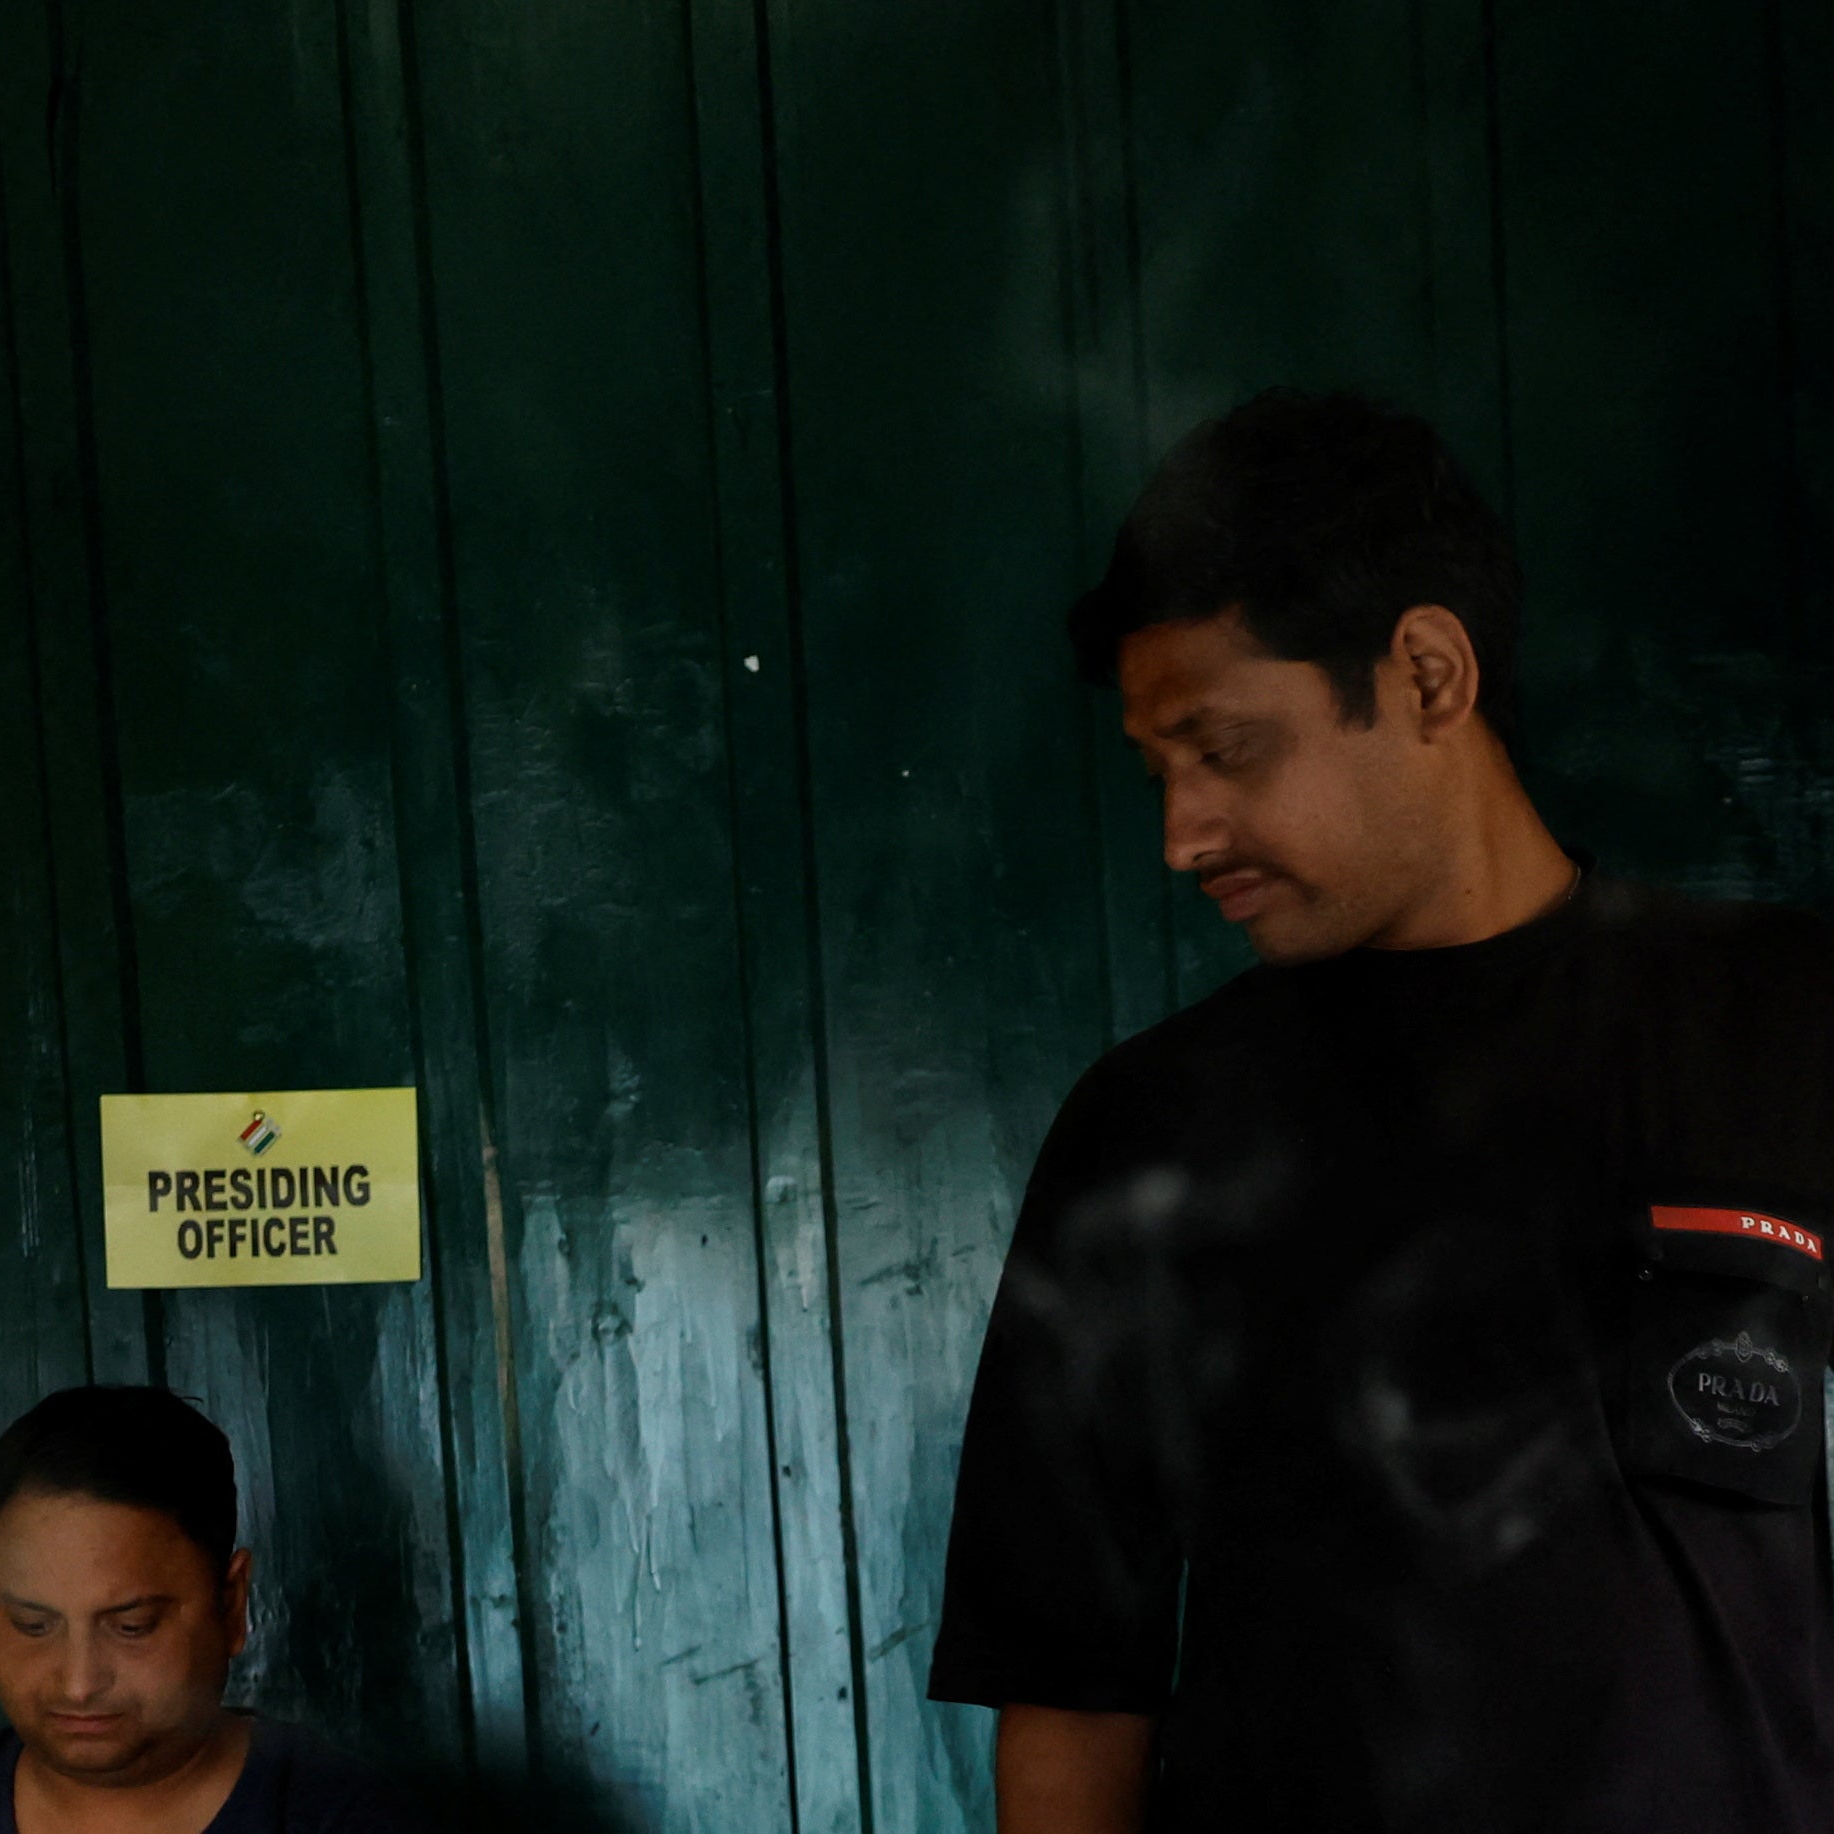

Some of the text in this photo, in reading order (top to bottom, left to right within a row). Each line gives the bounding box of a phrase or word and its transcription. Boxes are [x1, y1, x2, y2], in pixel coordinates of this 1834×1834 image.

[147, 1164, 371, 1212] PRESIDING
[177, 1215, 338, 1259] OFFICER
[1740, 1216, 1818, 1253] PRADA
[1698, 1372, 1780, 1406] PRADA
